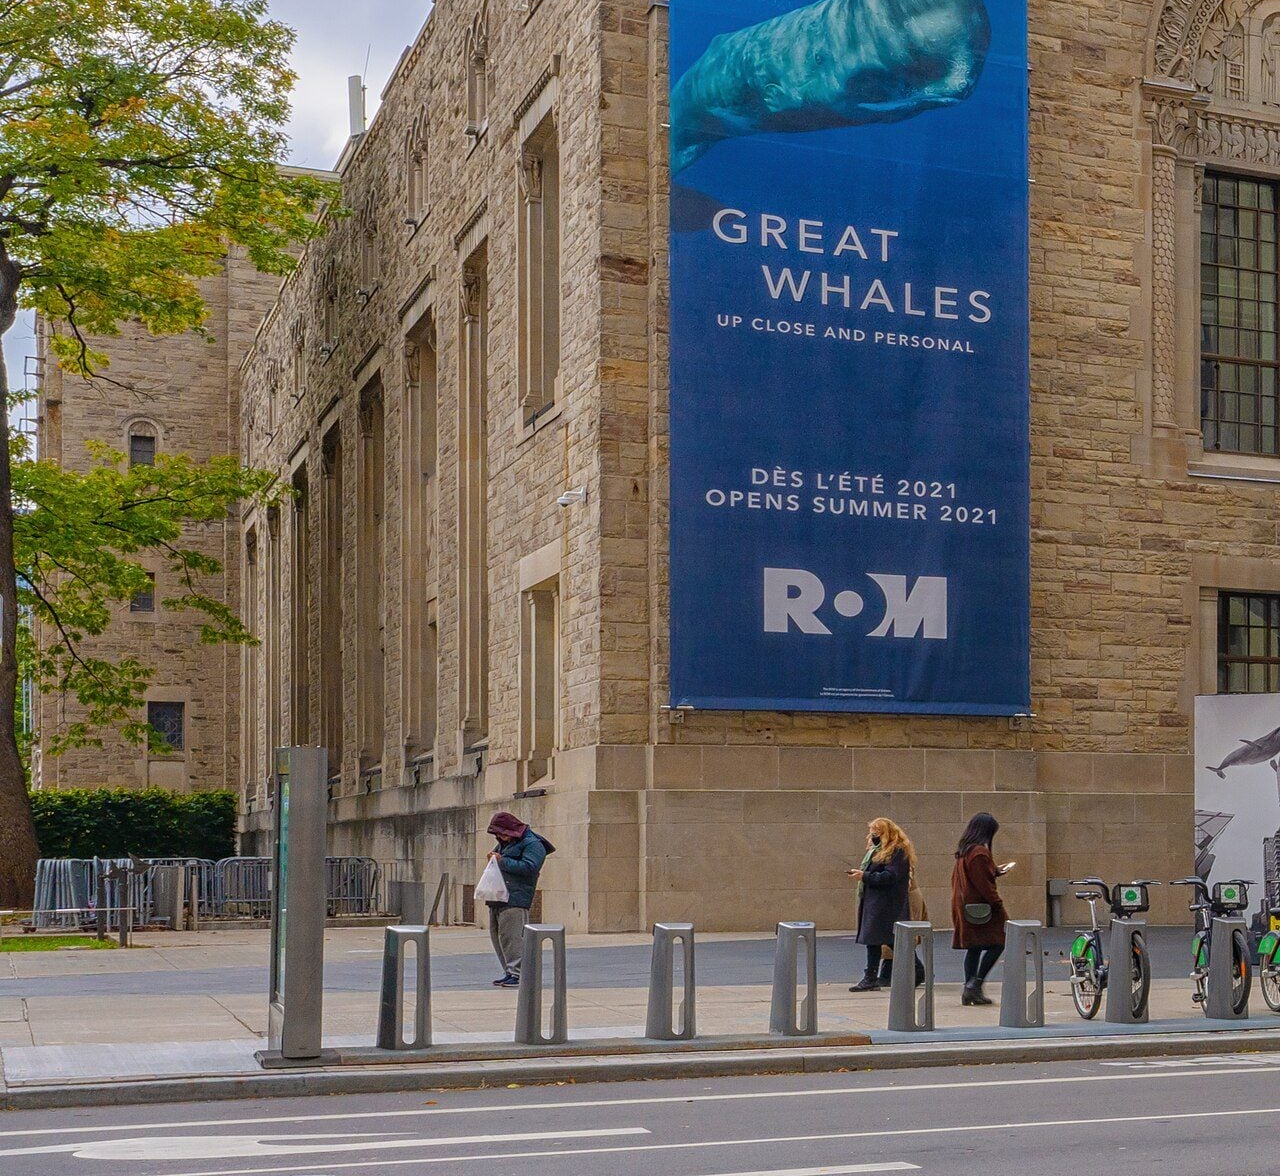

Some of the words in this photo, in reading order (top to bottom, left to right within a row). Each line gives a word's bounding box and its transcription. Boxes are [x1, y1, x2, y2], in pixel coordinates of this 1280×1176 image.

[712, 208, 899, 262] GREAT
[761, 264, 993, 323] WHALES
[717, 314, 743, 328] UP
[751, 318, 816, 337] CLOSE
[823, 326, 866, 342] AND
[874, 331, 974, 353] PERSONAL
[751, 465, 804, 488] DÈS
[817, 470, 885, 494] L'ÉTÉ
[897, 479, 957, 499] 2021
[705, 489, 800, 517] OPENS
[812, 496, 927, 521] SUMMER
[940, 505, 997, 525] 2021
